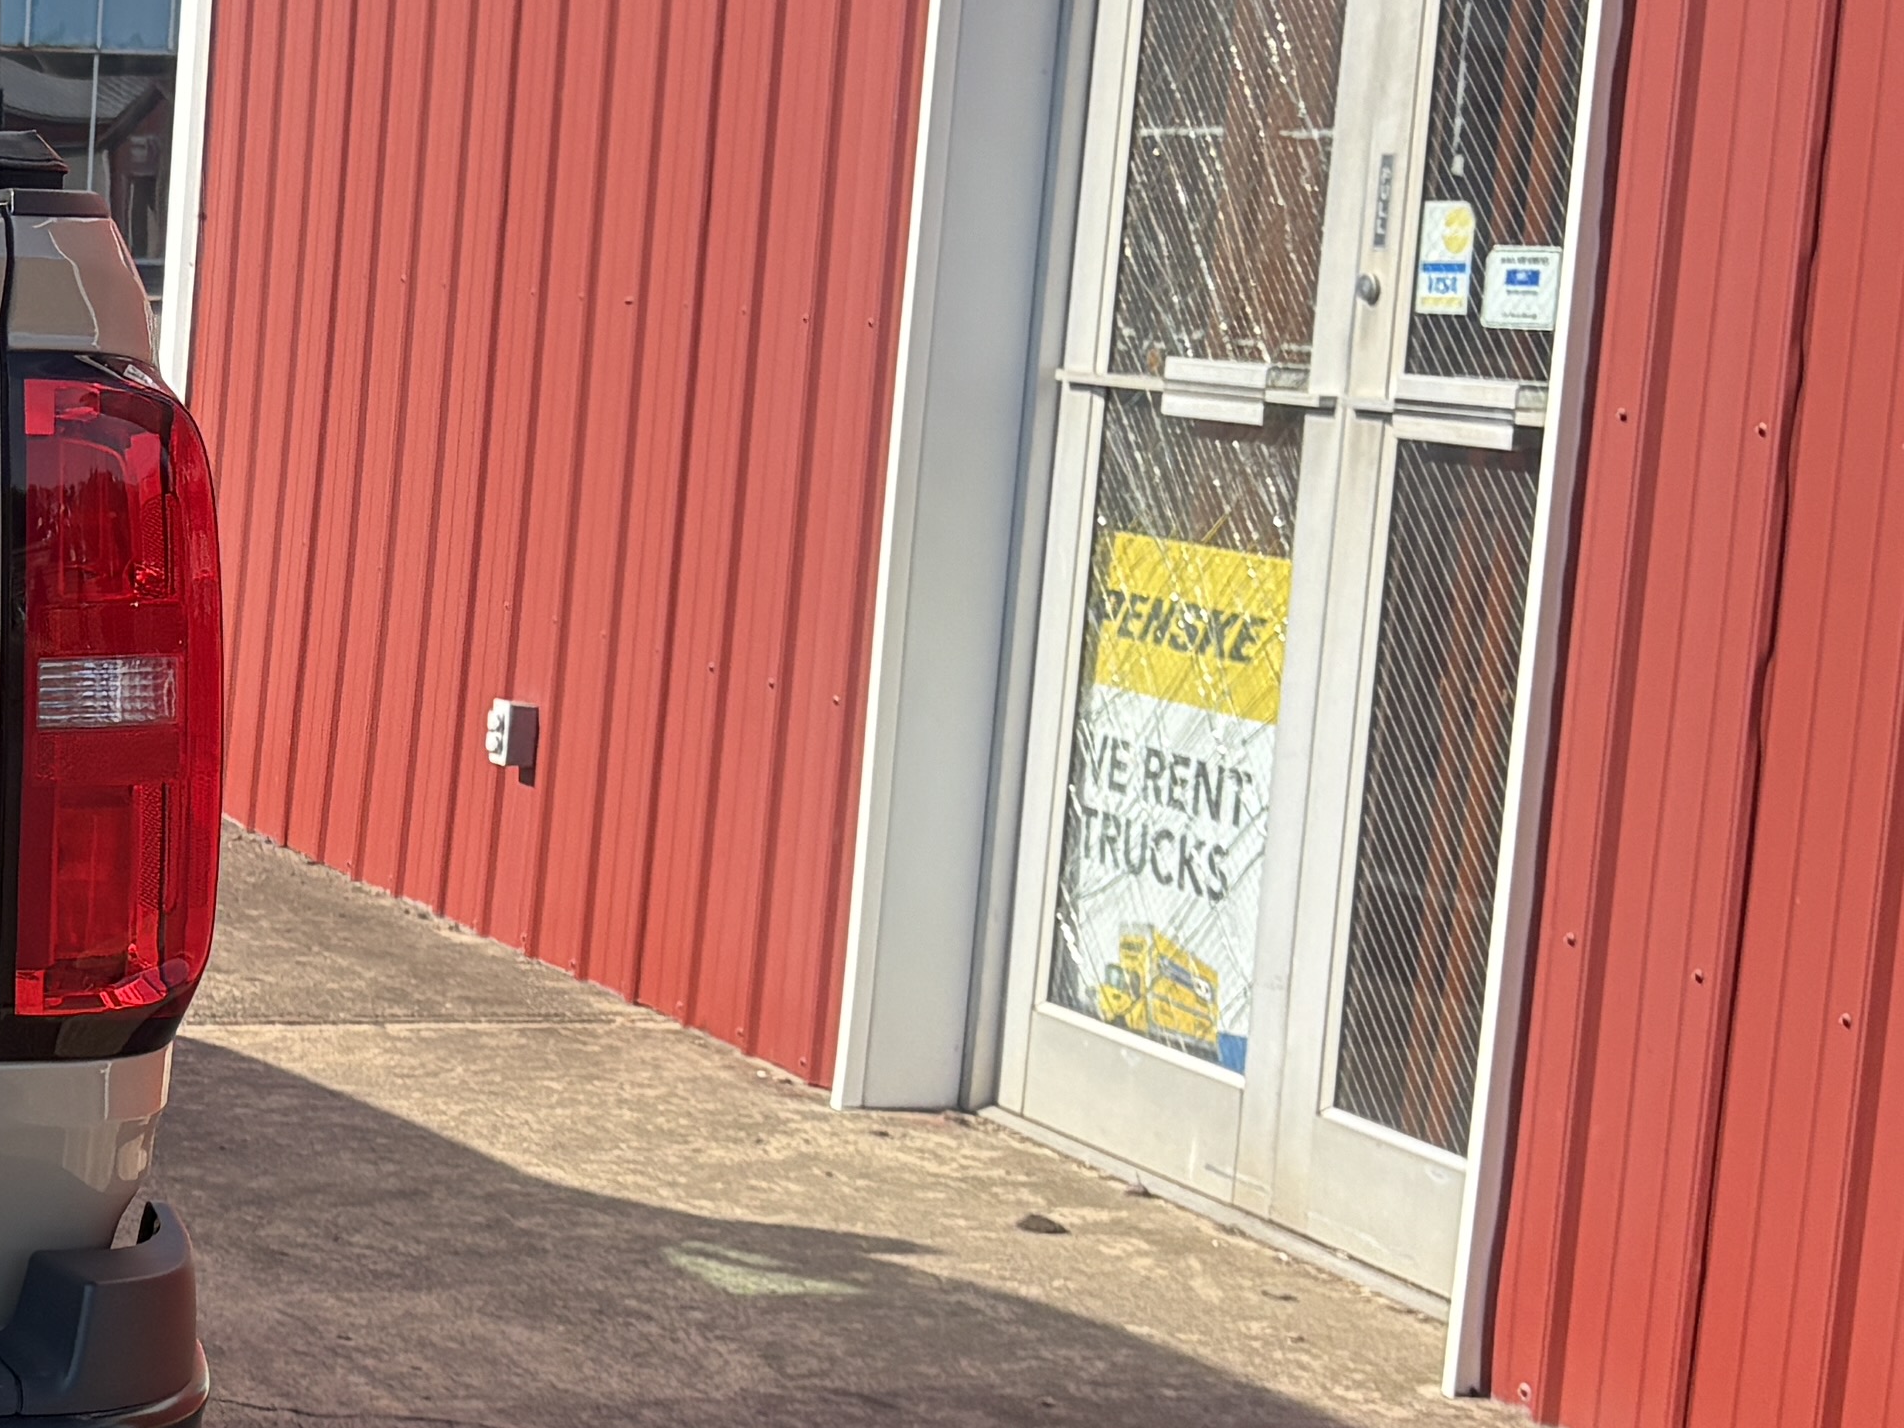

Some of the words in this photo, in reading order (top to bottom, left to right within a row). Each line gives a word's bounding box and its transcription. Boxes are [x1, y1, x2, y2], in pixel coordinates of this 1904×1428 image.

[1095, 589, 1269, 664] PENSKE
[1144, 746, 1253, 827] RENT
[1080, 805, 1228, 902] TRUCKS
